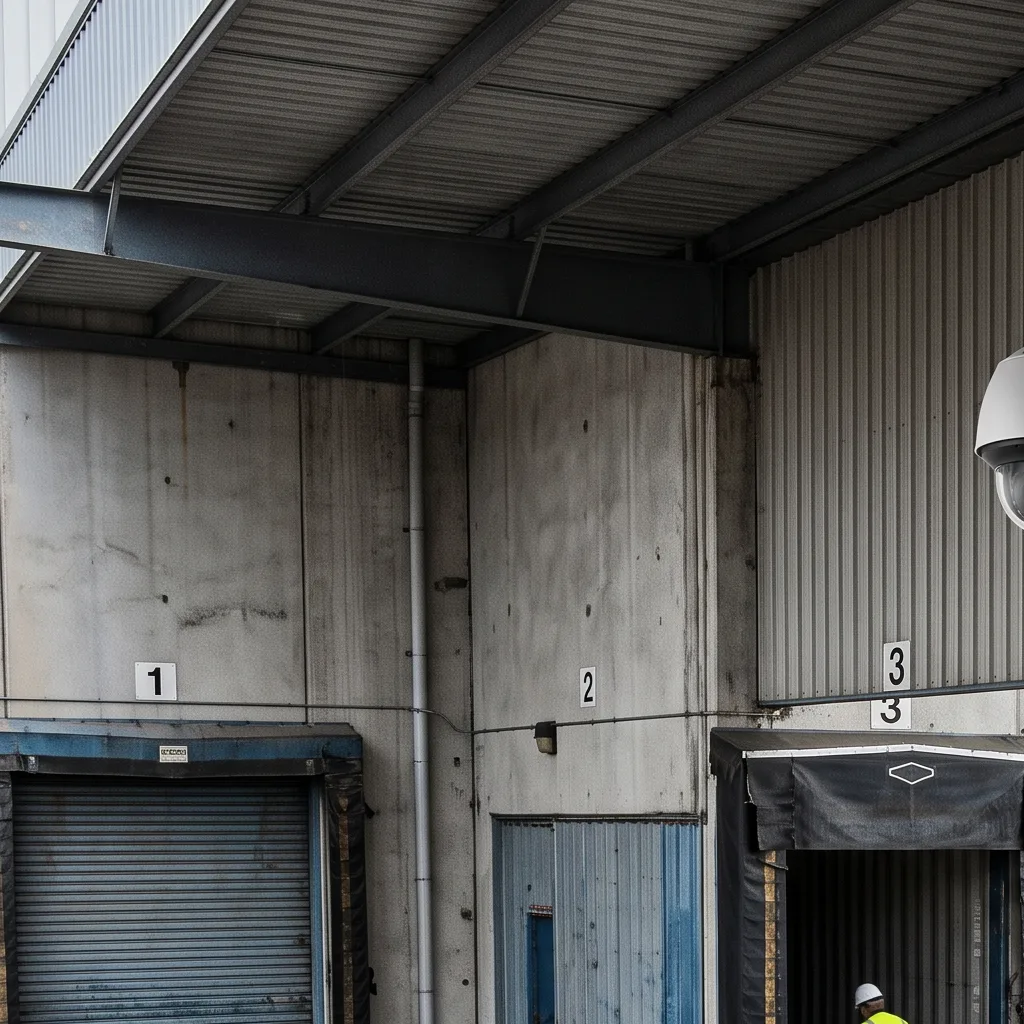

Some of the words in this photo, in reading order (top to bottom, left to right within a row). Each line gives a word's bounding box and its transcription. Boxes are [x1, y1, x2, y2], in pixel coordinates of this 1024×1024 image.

[147, 667, 162, 696] 1
[888, 647, 905, 686] 3
[583, 671, 594, 703] 2
[880, 697, 902, 724] 3
